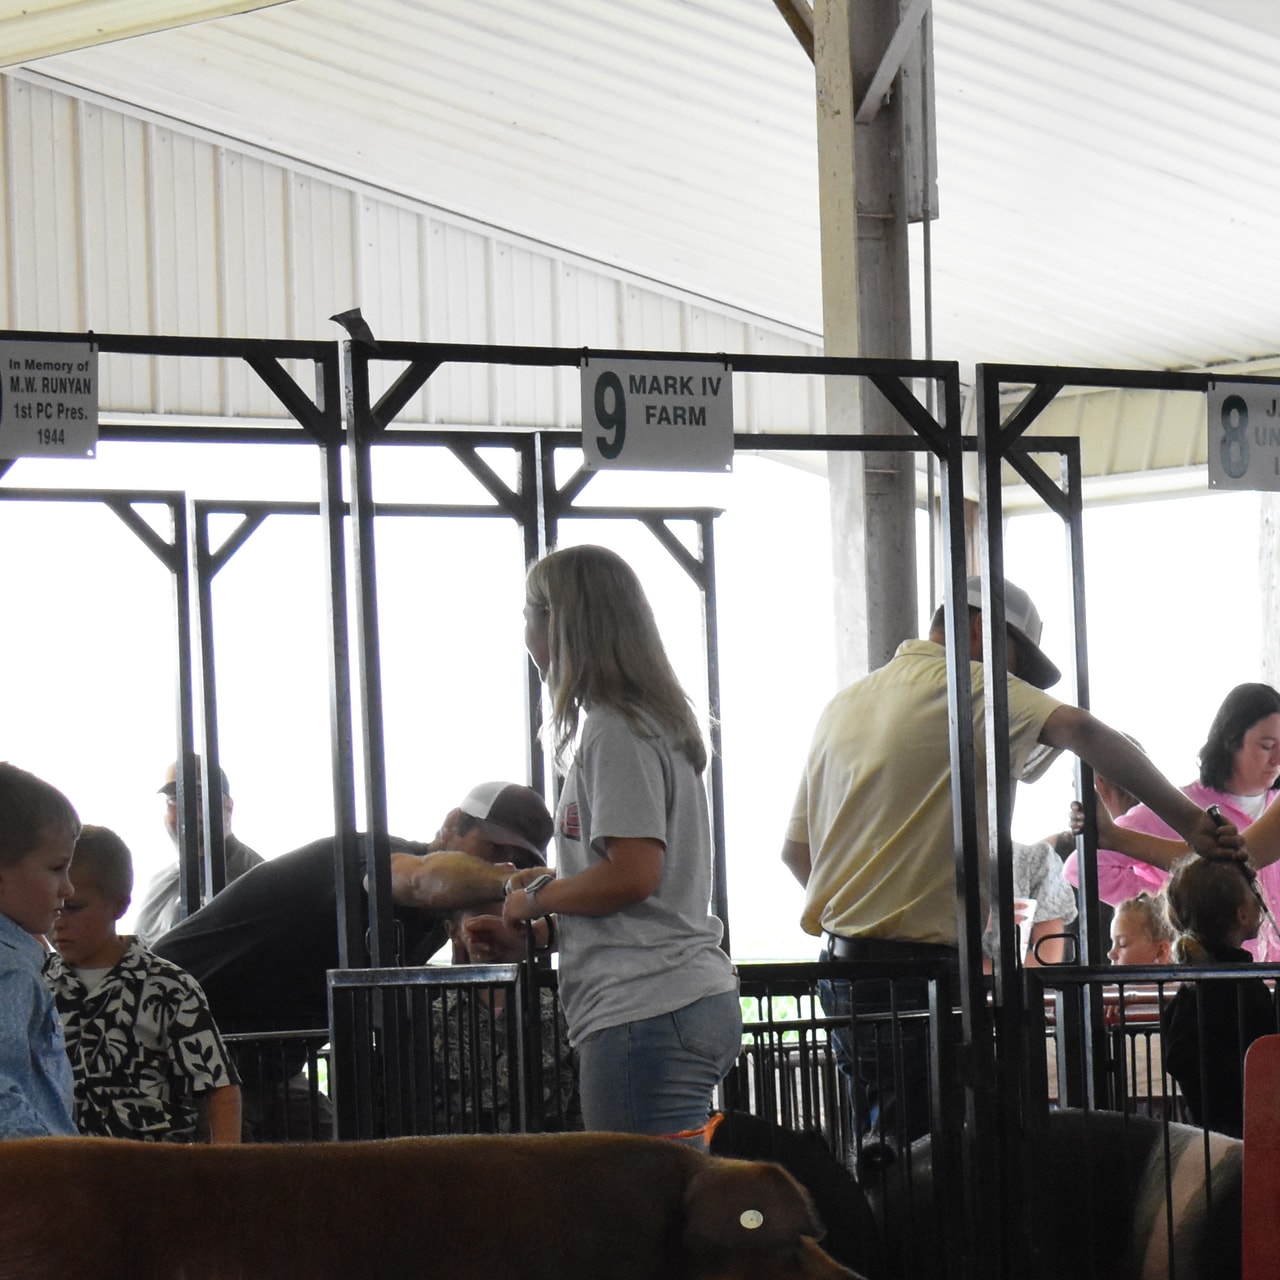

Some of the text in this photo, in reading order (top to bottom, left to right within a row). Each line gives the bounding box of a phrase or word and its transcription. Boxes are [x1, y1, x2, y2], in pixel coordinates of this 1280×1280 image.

[9, 359, 90, 374] In Memory of
[10, 376, 92, 395] M.W. RUNYAN
[629, 374, 722, 396] MARK IV
[14, 402, 88, 420] 1st PC Pres.
[594, 371, 627, 460] 9
[645, 405, 707, 426] FARM
[38, 428, 66, 445] 1944
[1220, 394, 1249, 479] 8
